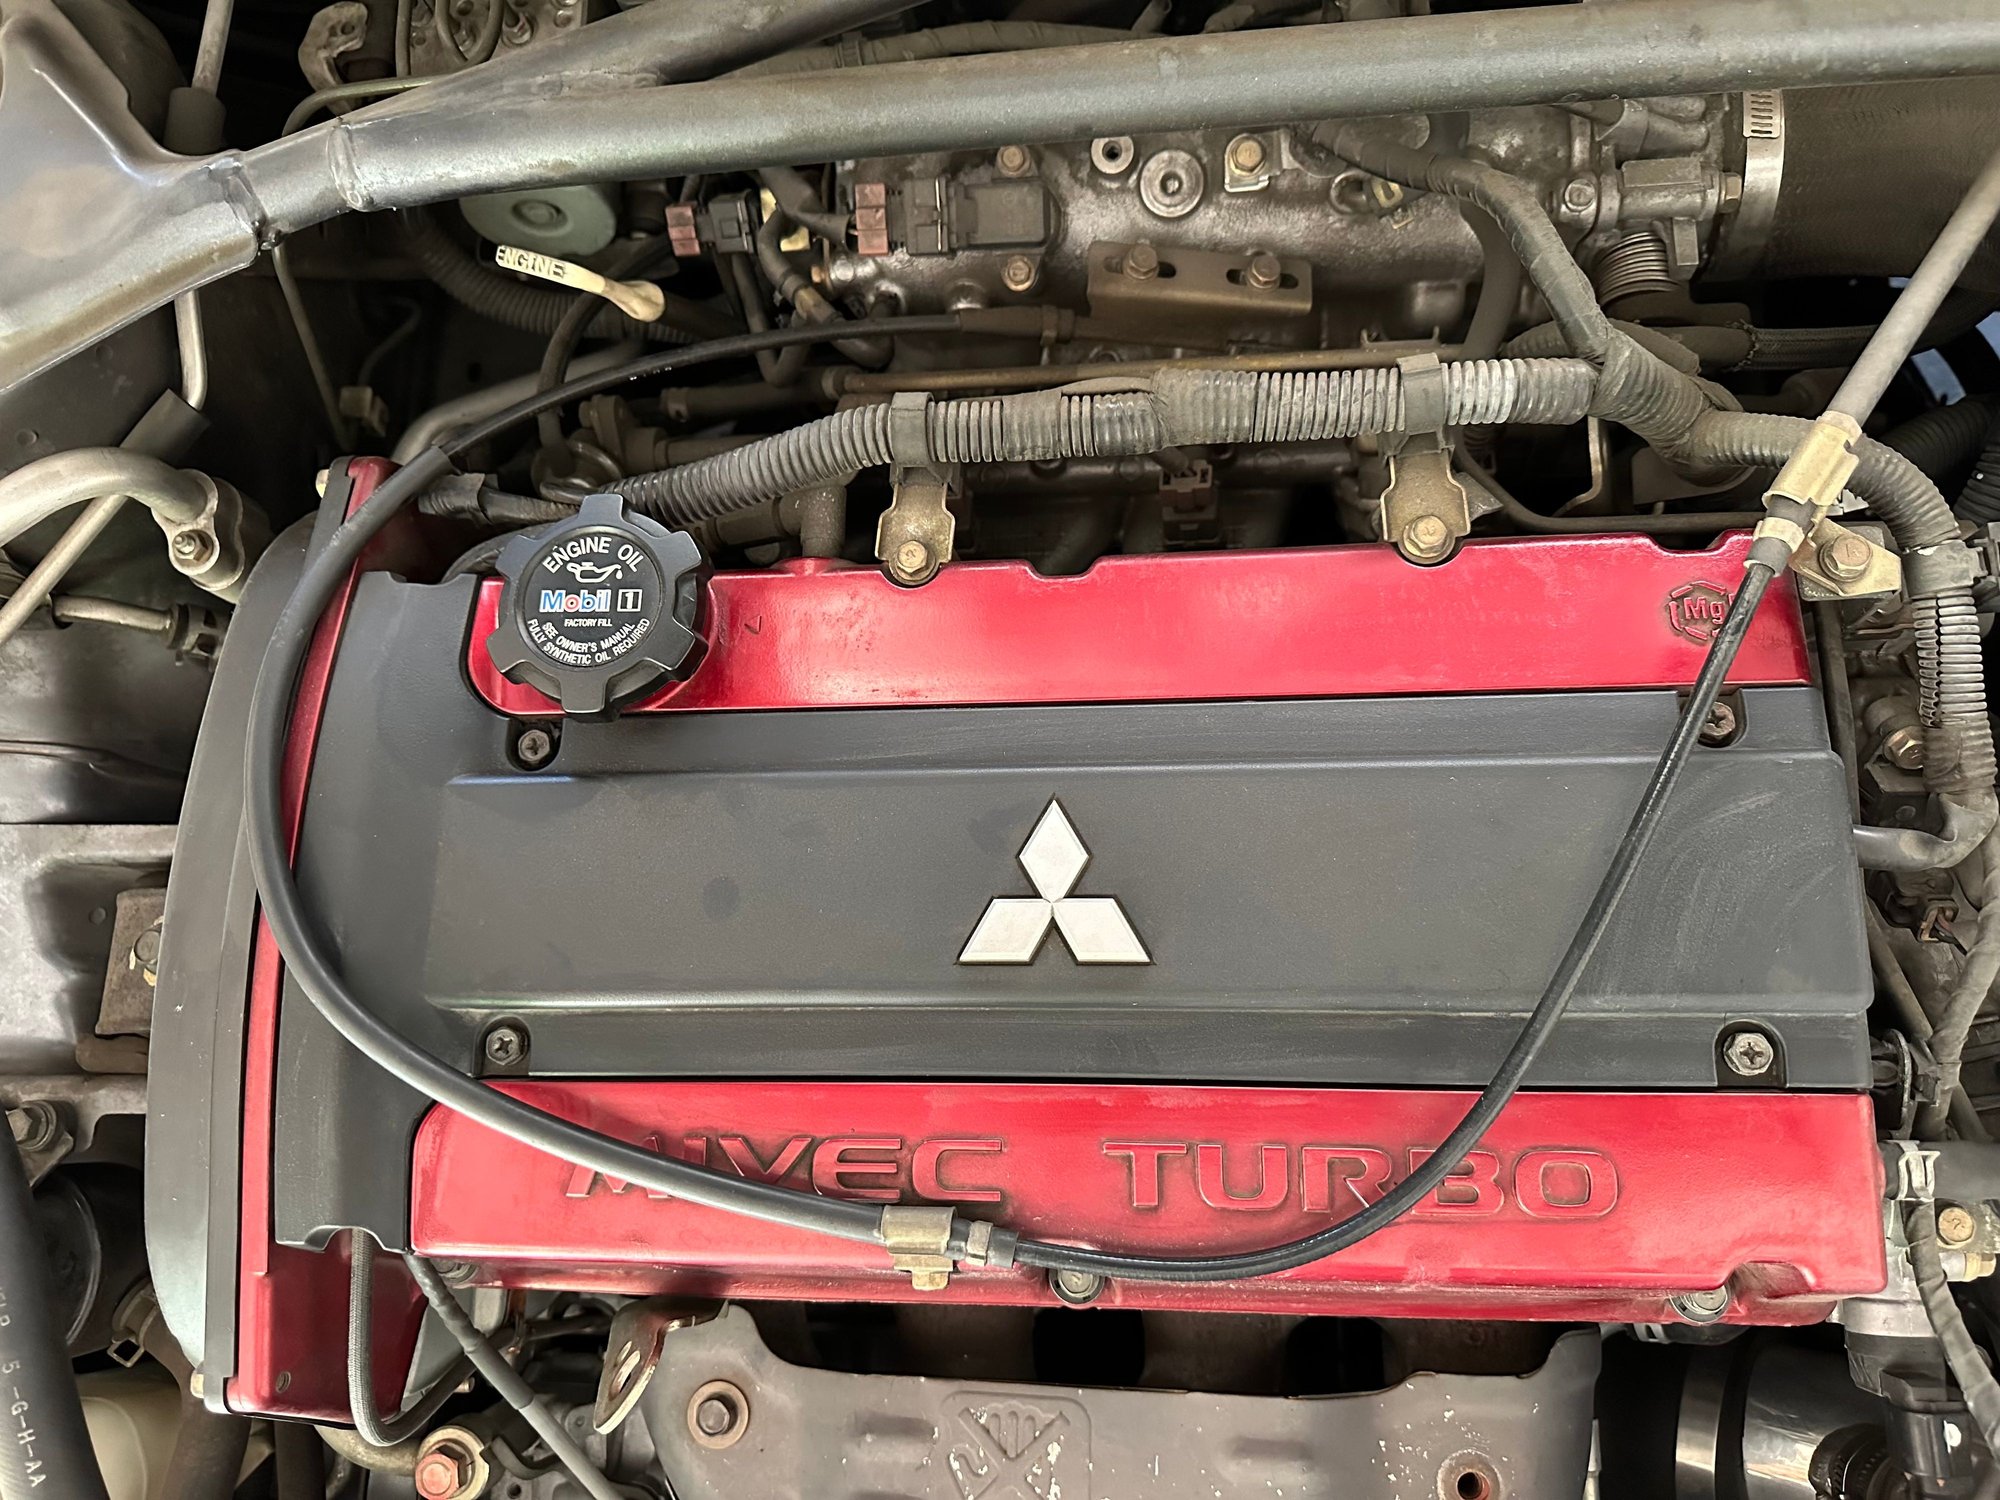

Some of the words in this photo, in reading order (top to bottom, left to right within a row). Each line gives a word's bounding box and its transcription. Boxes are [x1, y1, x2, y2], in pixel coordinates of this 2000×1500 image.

[498, 246, 566, 278] ENGINE
[542, 536, 612, 574] ENGINE
[617, 544, 645, 573] OIL
[539, 589, 612, 613] Mobil
[617, 589, 643, 612] 1
[1683, 596, 1726, 625] Mg
[542, 622, 559, 640] SEE
[556, 635, 598, 653] OWNER'S
[600, 622, 636, 650] MANUAL
[564, 618, 597, 627] FACTORY
[597, 618, 613, 627] FILL
[527, 618, 547, 644] FULLY
[543, 642, 592, 665] SYNTHETIC
[595, 652, 612, 663] OIL
[612, 618, 650, 657] REQUIRED
[1102, 1140, 1620, 1219] TURBO
